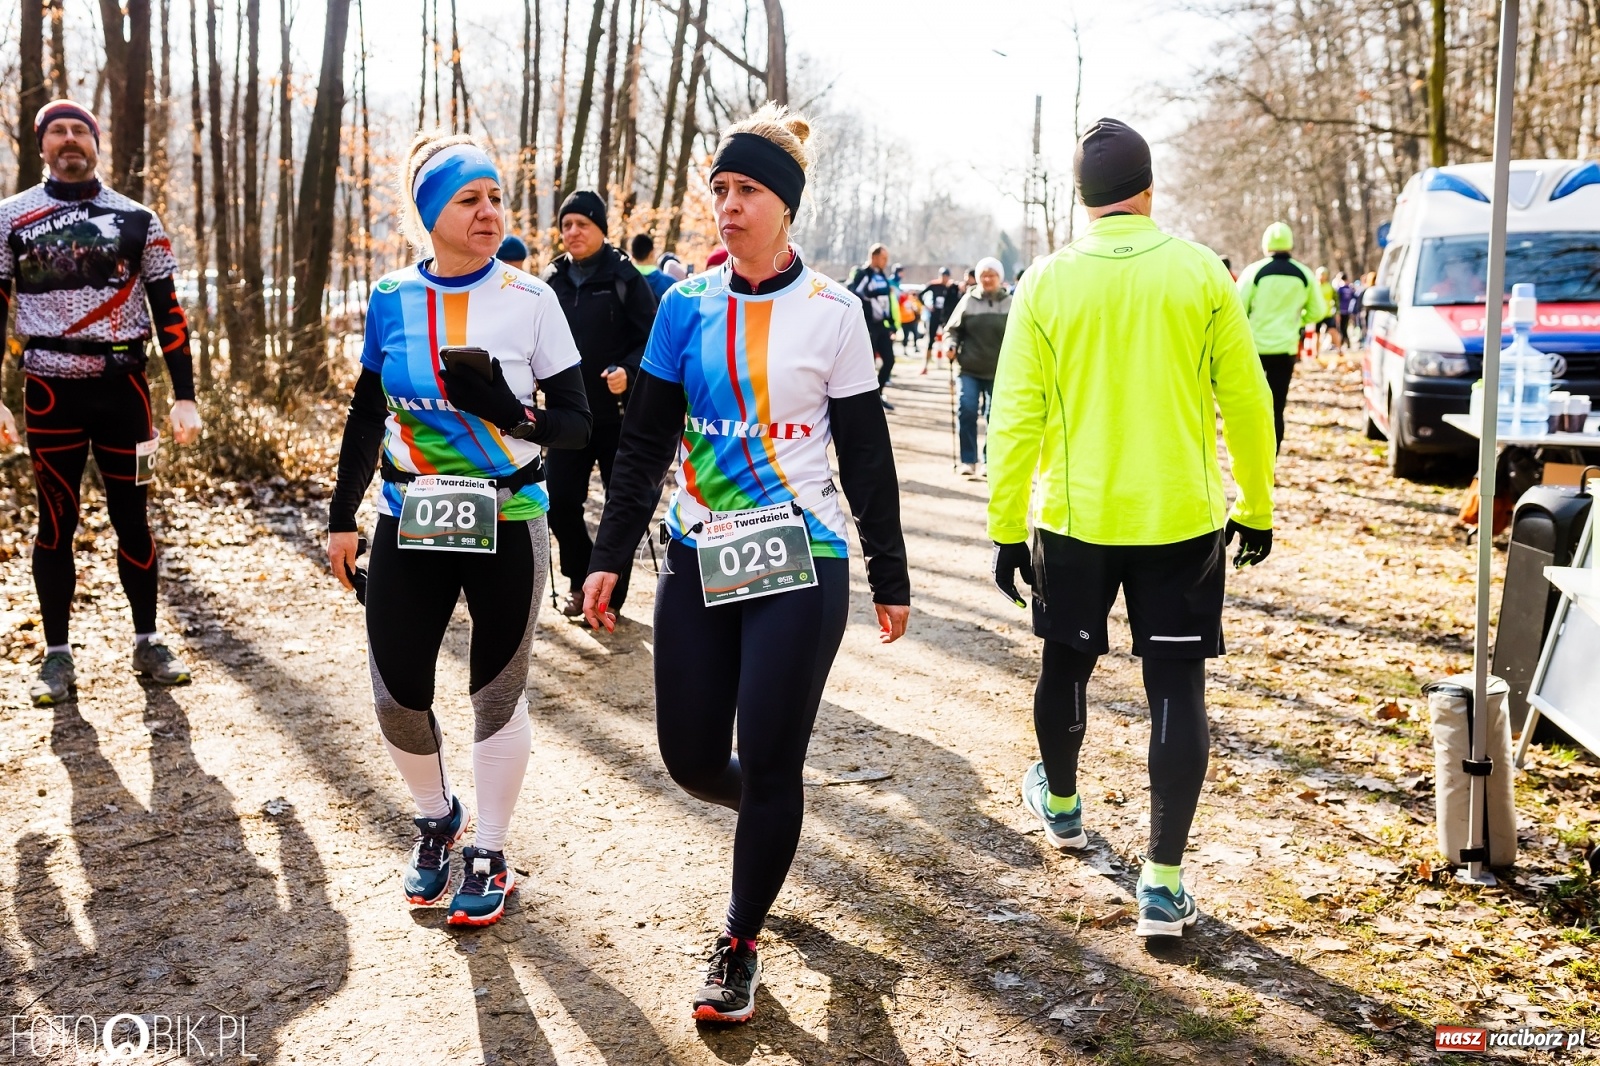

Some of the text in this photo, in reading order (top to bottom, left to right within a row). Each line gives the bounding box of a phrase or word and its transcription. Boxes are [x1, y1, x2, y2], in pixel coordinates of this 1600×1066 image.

[20, 220, 53, 245] FURIA
[53, 208, 89, 230] WOJÓW
[436, 478, 485, 489] Twardziela
[416, 499, 476, 529] 028
[707, 526, 712, 535] X
[713, 522, 733, 533] BIEG
[734, 512, 789, 529] Twardziela
[719, 537, 788, 576] 029
